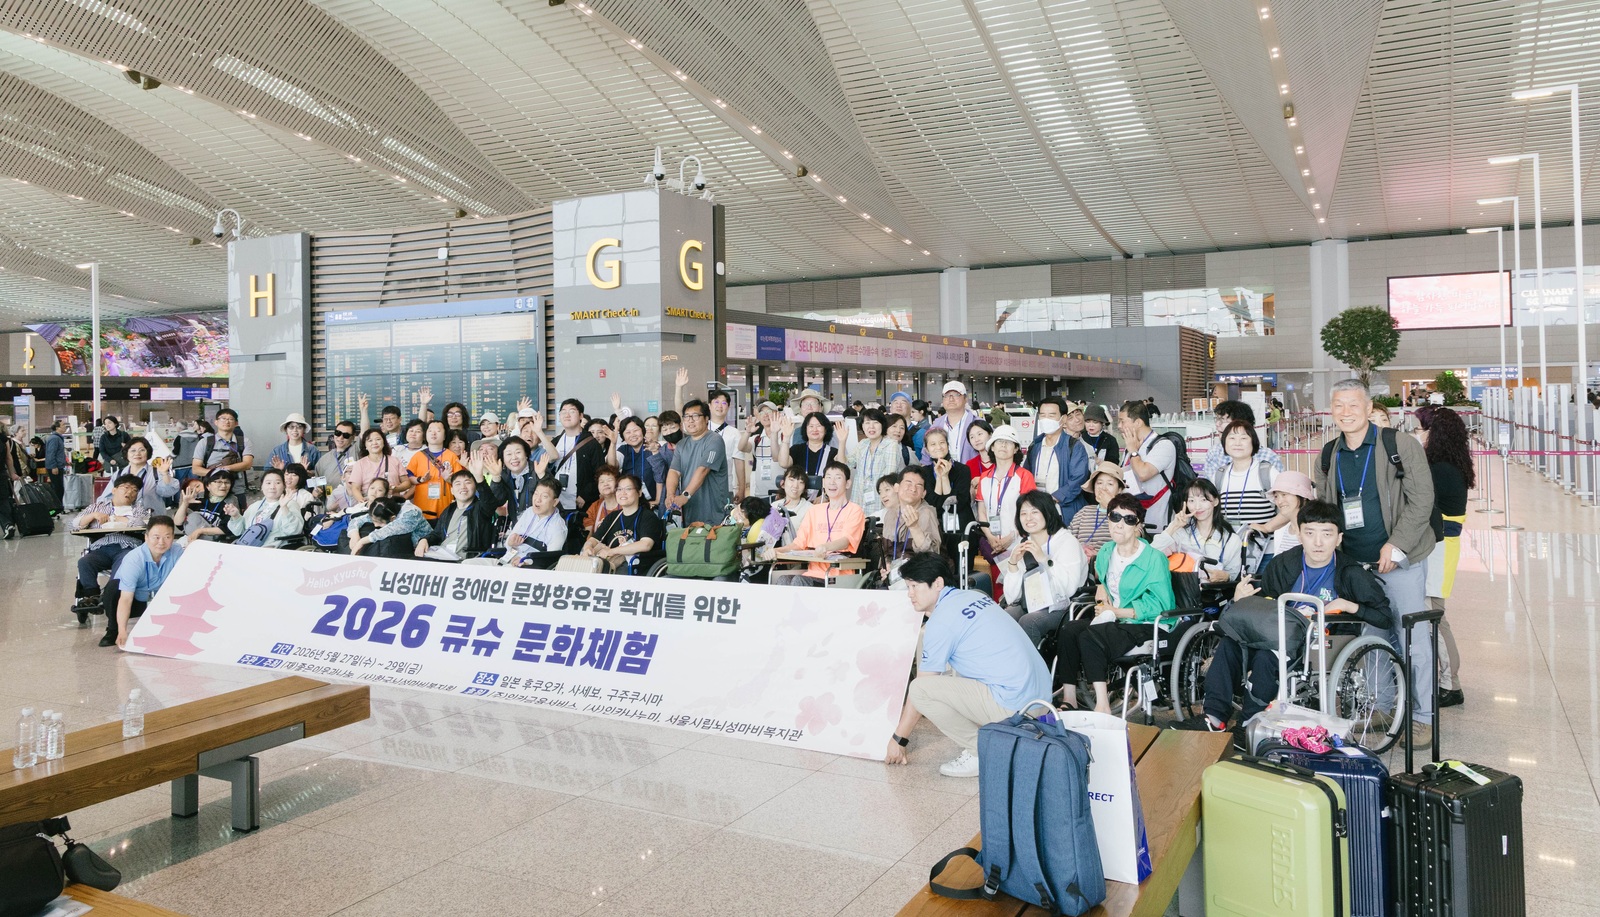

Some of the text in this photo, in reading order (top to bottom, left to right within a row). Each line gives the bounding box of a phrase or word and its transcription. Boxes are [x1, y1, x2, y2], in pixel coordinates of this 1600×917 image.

[585, 237, 621, 290] G
[679, 239, 704, 291] G
[249, 273, 276, 317] H
[569, 309, 601, 321] SMART
[665, 306, 689, 317] SMART
[798, 340, 814, 353] SELF
[814, 341, 828, 354] BAG
[827, 342, 845, 355] DROP
[1208, 341, 1215, 359] G
[379, 571, 741, 625] 뇌성마비 장애인 문화향유권 확대를 위한
[273, 643, 292, 656] 기간
[311, 594, 659, 675] 2026 큐슈 문화체험
[293, 646, 326, 661] 2026년
[324, 651, 341, 663] 5월
[339, 653, 377, 669] 27일(수)
[384, 660, 424, 676] 29일(금)
[475, 672, 496, 685] 장소
[500, 675, 664, 707] 일본 후쿠오카, 사세보, 구주쿠시마
[664, 712, 804, 743] 서울시립뇌성마비복지관
